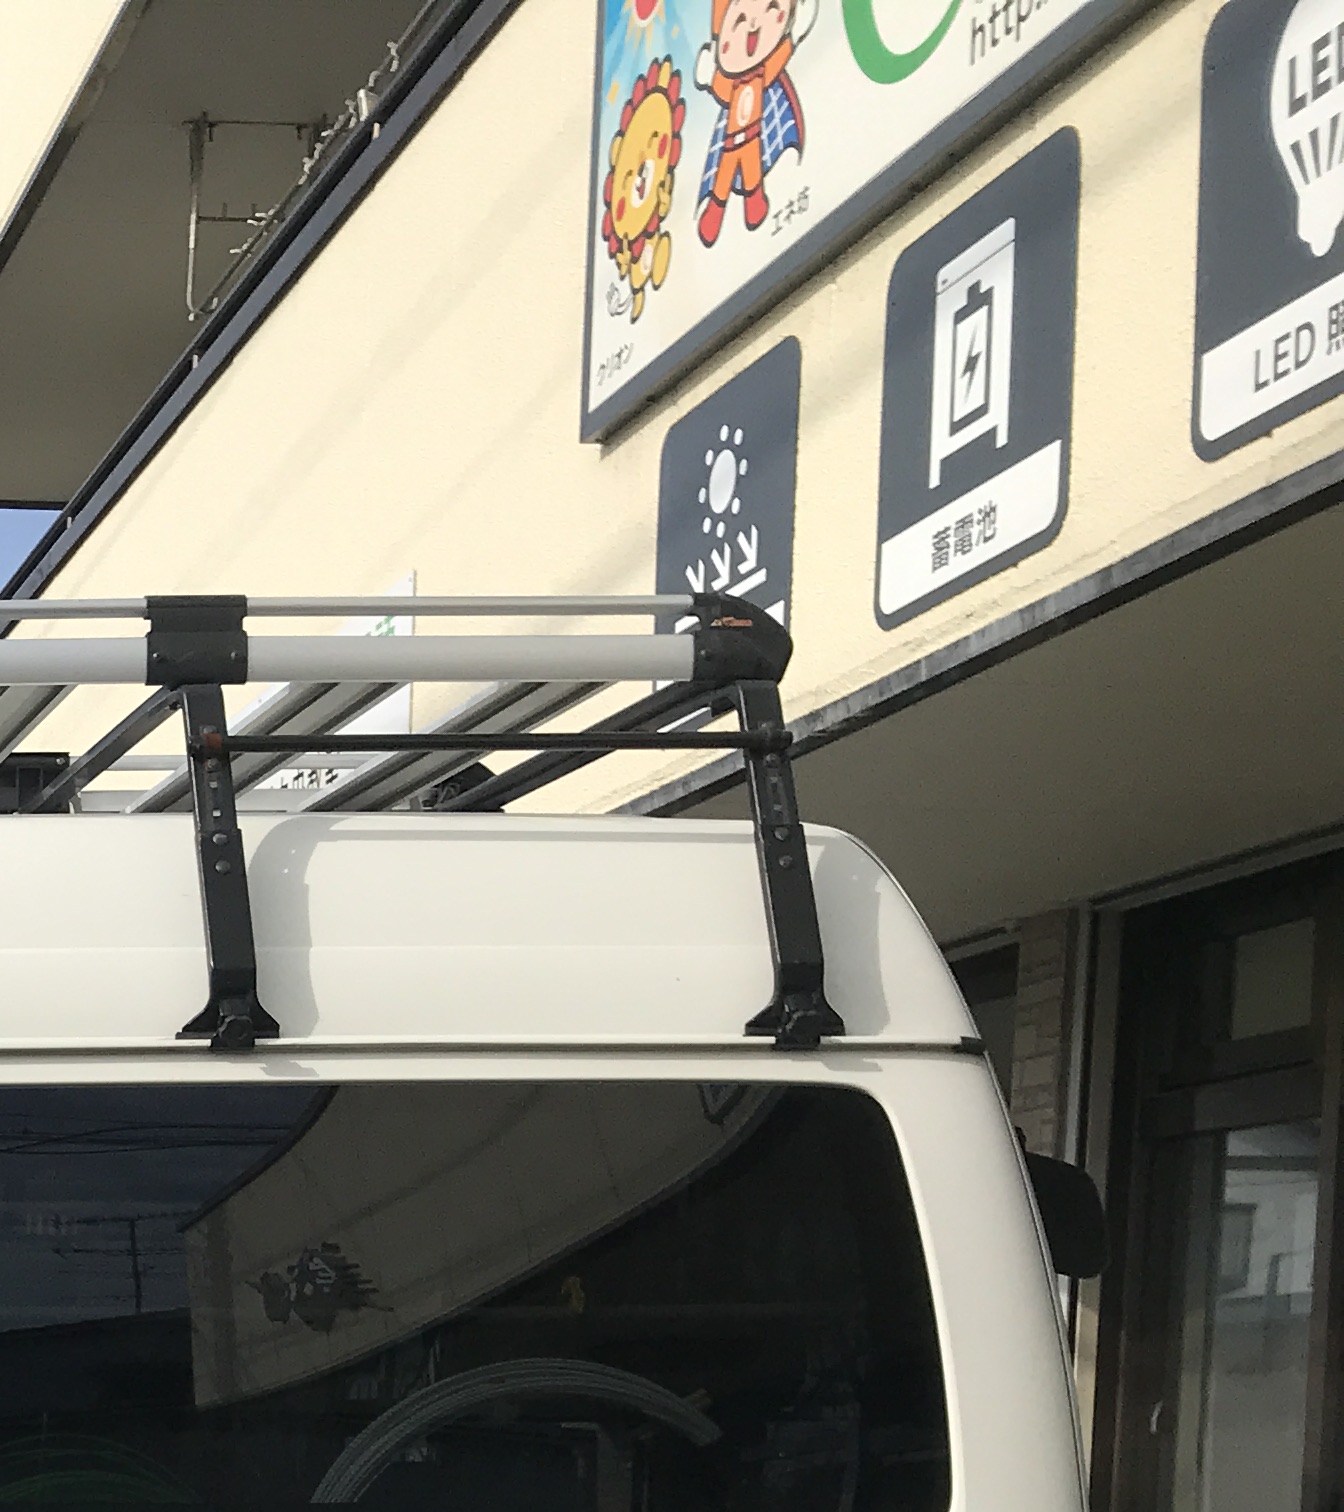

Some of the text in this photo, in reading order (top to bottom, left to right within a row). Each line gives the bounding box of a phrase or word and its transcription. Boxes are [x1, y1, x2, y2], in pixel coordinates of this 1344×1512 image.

[771, 185, 810, 237] エネ坊
[1254, 320, 1316, 394] LED
[931, 499, 998, 574] 蓄電池
